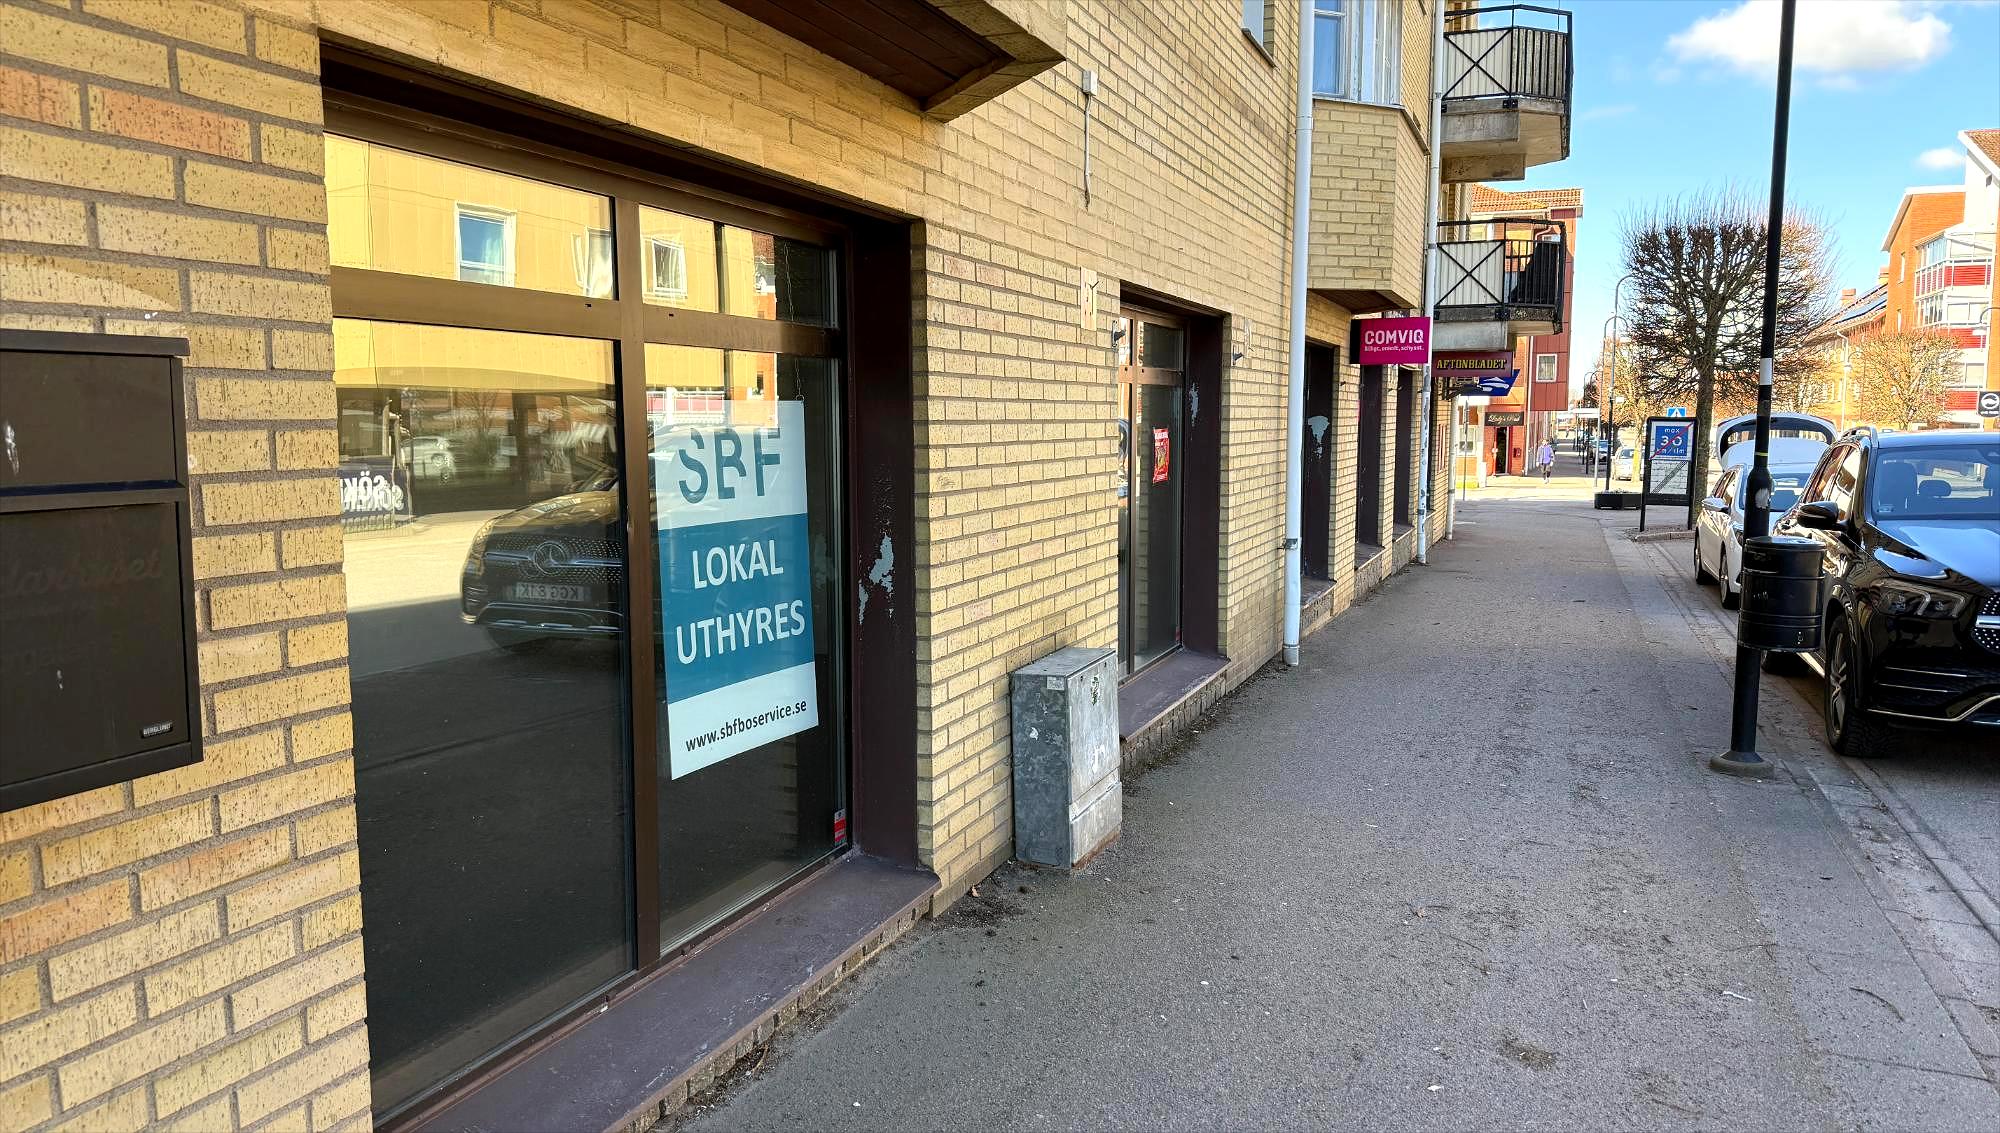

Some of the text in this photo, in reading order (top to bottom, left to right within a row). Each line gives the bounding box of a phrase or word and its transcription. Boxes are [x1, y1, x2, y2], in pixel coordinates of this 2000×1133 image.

[1364, 329, 1424, 345] COMVIQ
[1437, 359, 1507, 370] AFTONBLADET
[679, 427, 781, 504] SBF
[1660, 435, 1682, 446] 30
[691, 539, 784, 590] LOKAL
[675, 599, 806, 665] UTHYRES
[685, 700, 807, 752] www.sbfboservice.se
